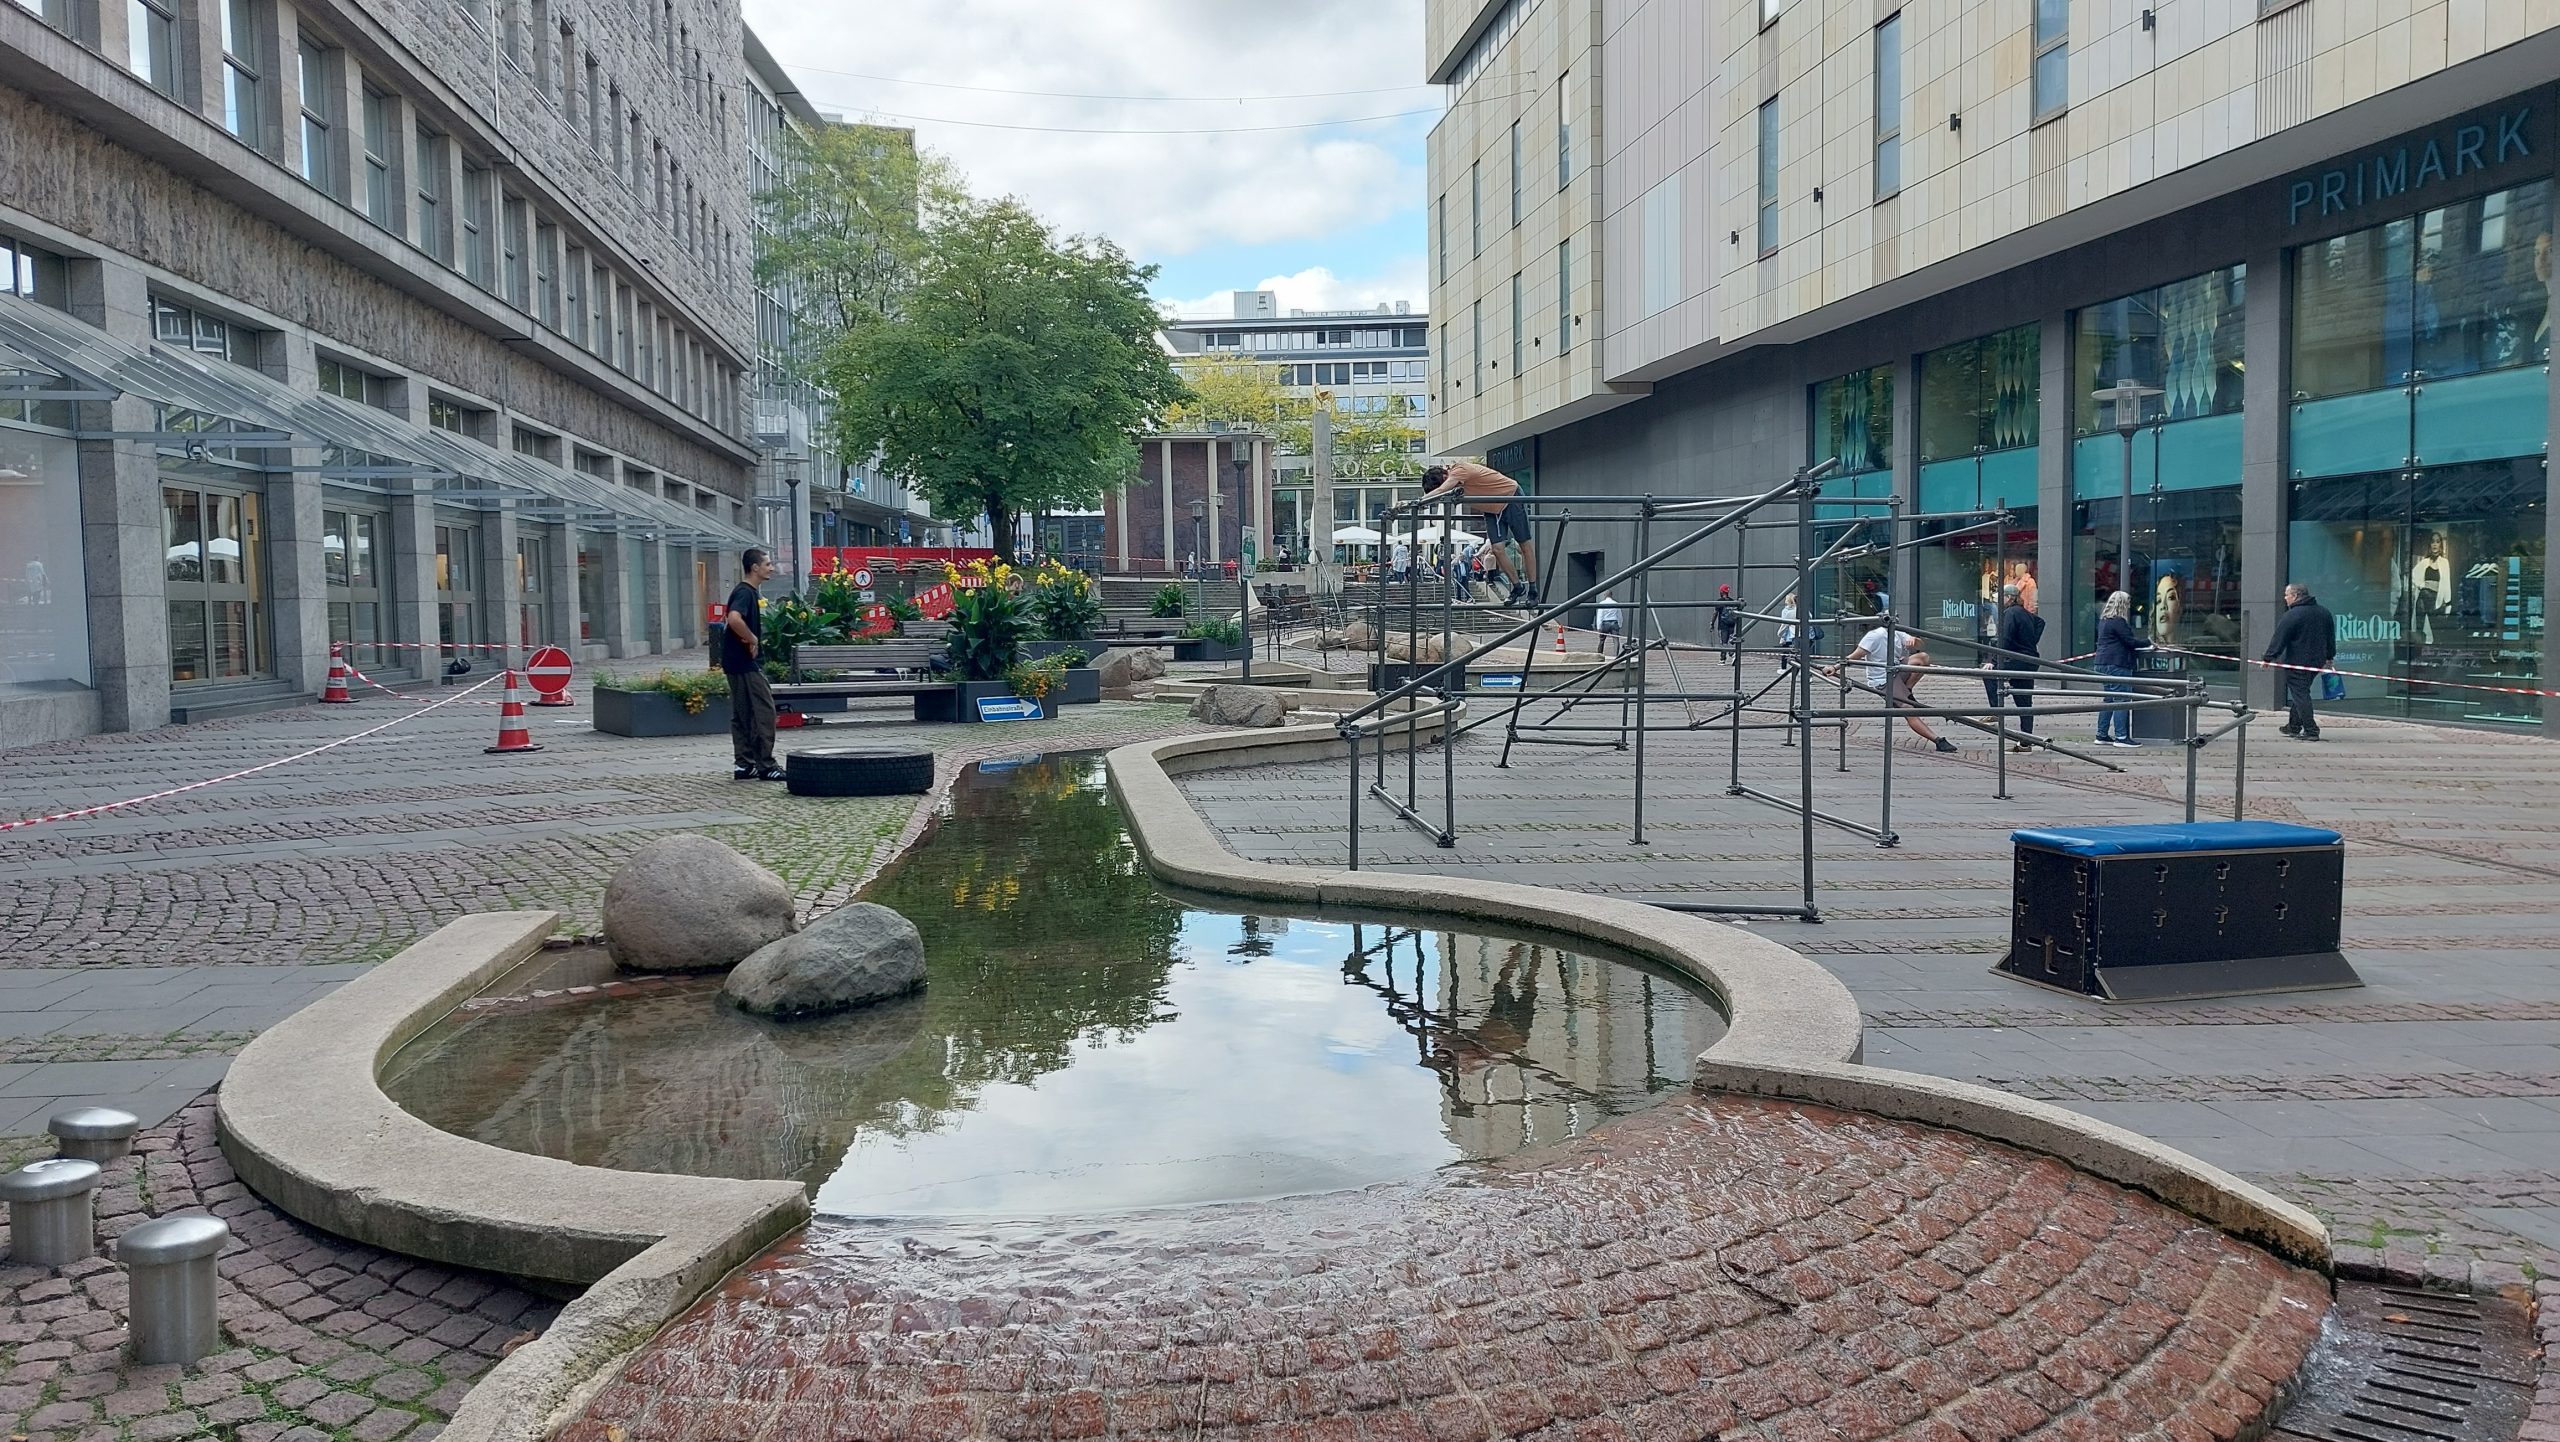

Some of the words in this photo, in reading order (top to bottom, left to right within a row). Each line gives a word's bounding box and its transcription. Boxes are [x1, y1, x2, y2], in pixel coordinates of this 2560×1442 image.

[2289, 107, 2530, 226] PRIMARK
[1492, 444, 1525, 468] PRIMARK
[1942, 598, 1960, 619] Rita
[1960, 599, 1976, 619] Ora
[2335, 612, 2368, 641] Rita
[2369, 614, 2402, 642] Ora
